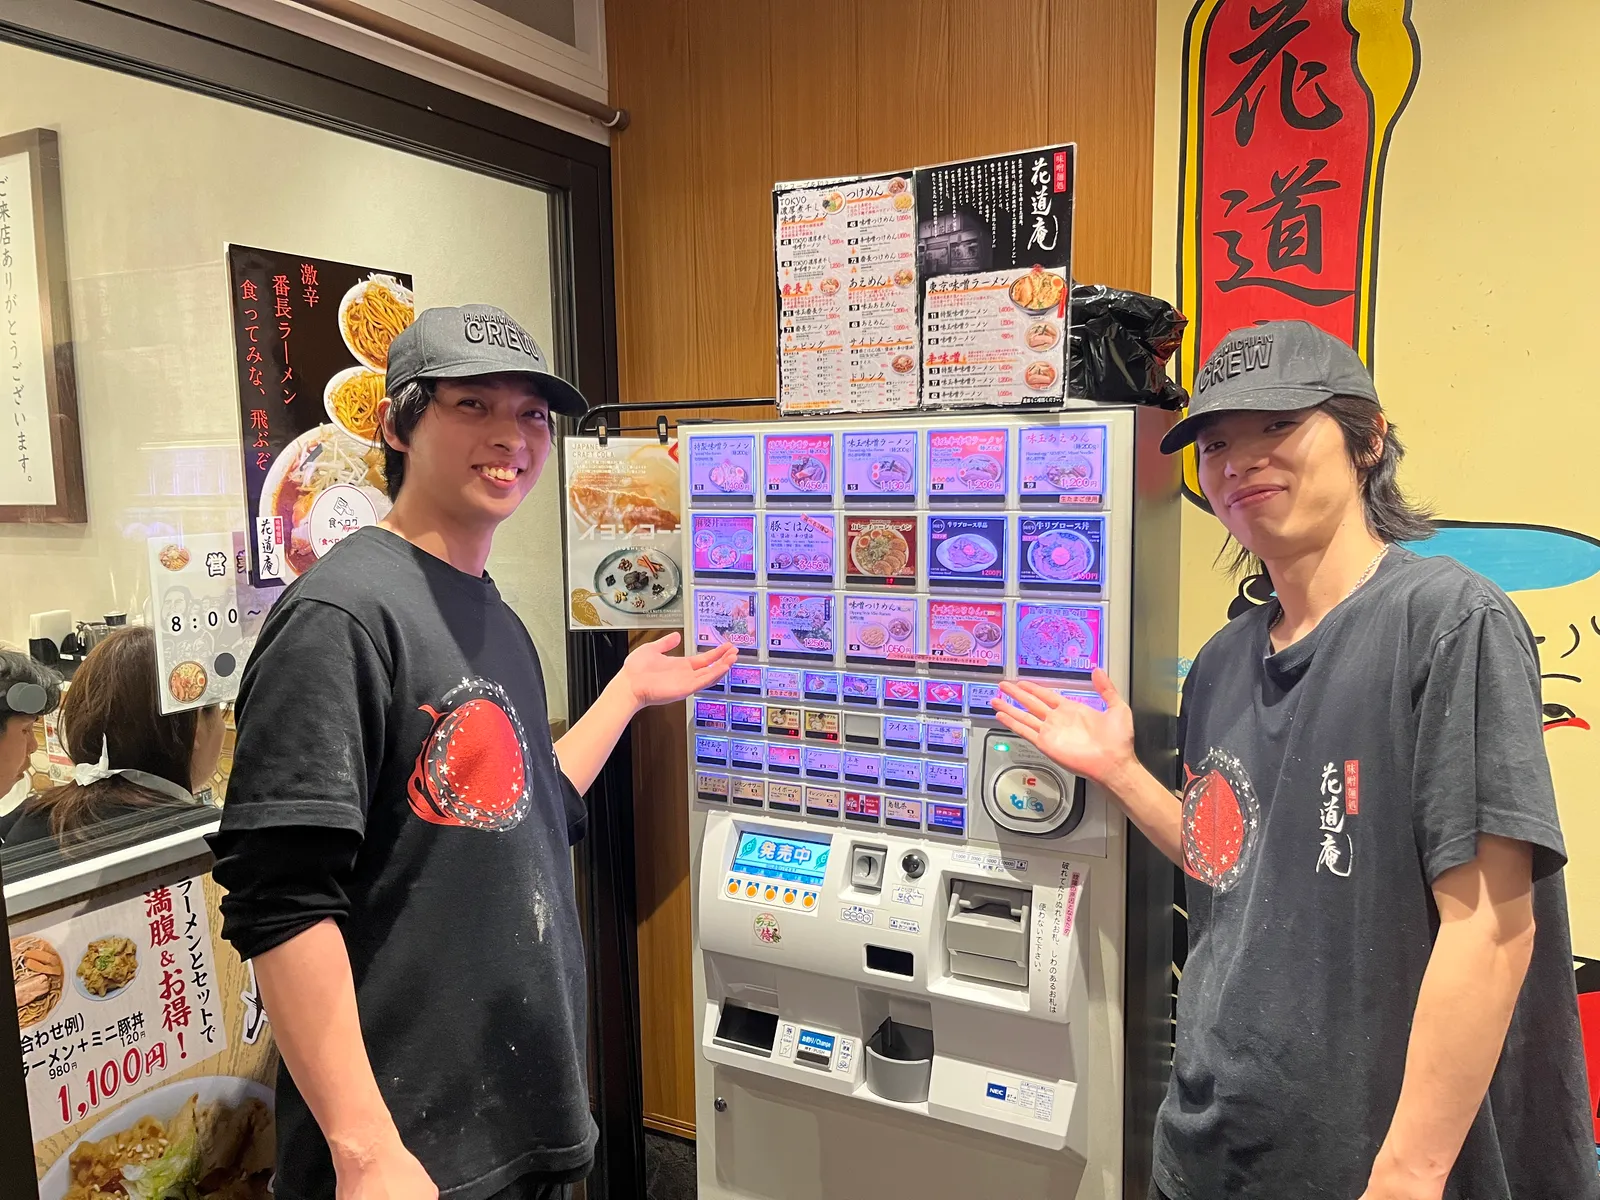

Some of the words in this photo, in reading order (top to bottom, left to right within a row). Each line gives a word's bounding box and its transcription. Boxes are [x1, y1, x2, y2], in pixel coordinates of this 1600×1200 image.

[1210, 0, 1355, 307] 花道
[846, 186, 884, 199] つけめん
[780, 196, 806, 206] TOKYO
[1027, 157, 1059, 250] 花道庵
[780, 213, 828, 224] 味噌ラーメン
[300, 263, 318, 308] 激辛
[848, 276, 886, 288] あえめん
[928, 276, 1010, 294] 東京味噌ラーメン
[940, 308, 988, 318] 特製味噌ラーメン
[272, 274, 296, 406] 番長ラーメン
[464, 320, 539, 362] CREW
[784, 340, 826, 350] トッピング
[850, 336, 912, 346] サイドメニュー
[927, 352, 960, 364] 辛味噌
[1199, 342, 1273, 394] CREW
[851, 372, 884, 382] ドリンク
[846, 438, 912, 448] 味玉味噌ラーメン
[1026, 432, 1090, 444] 味玉あえめん
[694, 442, 750, 450] 特製味噌ラーメン
[724, 482, 750, 490] 1,400円
[968, 480, 1002, 490] 1,200円
[1060, 478, 1098, 488] 1,200円
[328, 517, 358, 528] 食べログ
[770, 520, 814, 532] 豚ごはん
[1036, 522, 1090, 530] 牛リブロース丼
[260, 518, 280, 576] 花道庵
[849, 602, 896, 612] 味噌つけめん
[881, 644, 912, 654] 1,050円
[968, 650, 1000, 660] 1,100円
[888, 722, 908, 732] ライス
[1315, 762, 1353, 878] 花道庵
[758, 840, 812, 865] 発売中
[1034, 902, 1046, 972] 使わないで下さい。
[176, 875, 218, 1044] ラーメンとセットで
[120, 1030, 146, 1048] 120円
[49, 1062, 78, 1080] 980円
[57, 1042, 168, 1124] 1,100円
[989, 1088, 1004, 1096] NEC
